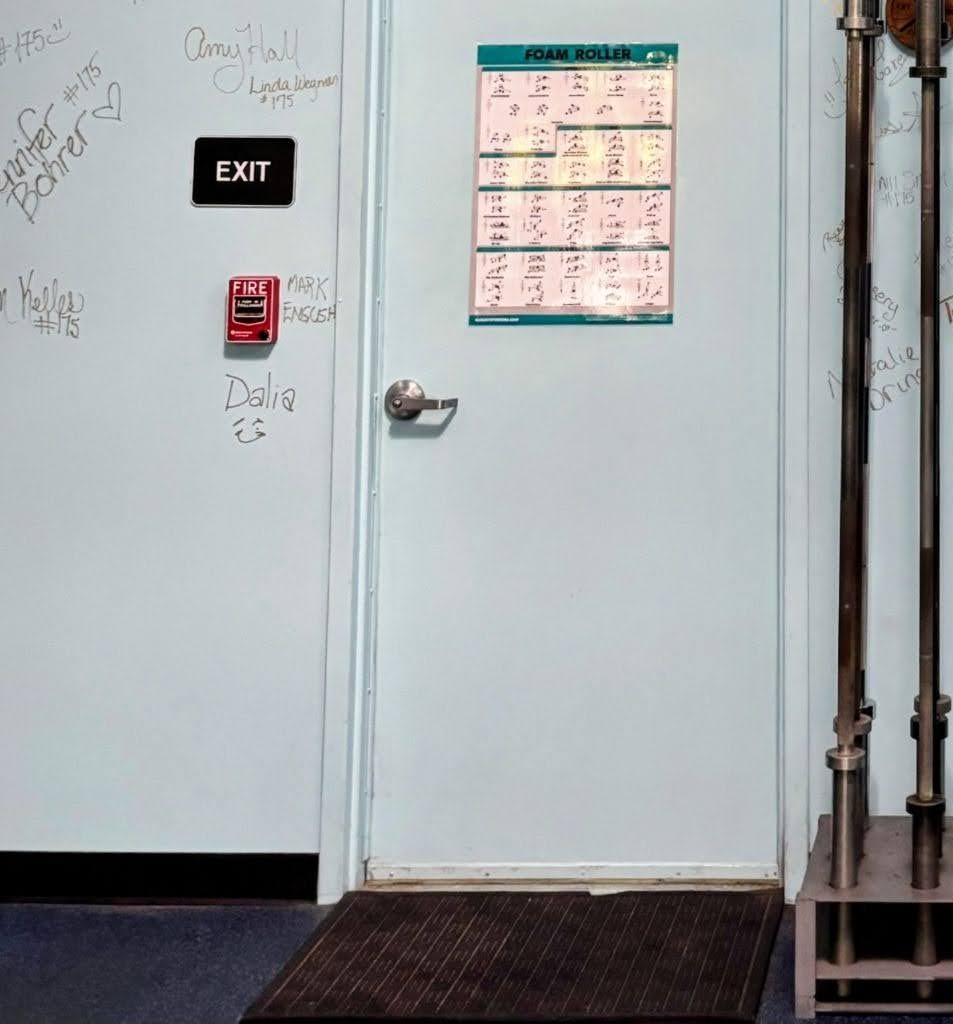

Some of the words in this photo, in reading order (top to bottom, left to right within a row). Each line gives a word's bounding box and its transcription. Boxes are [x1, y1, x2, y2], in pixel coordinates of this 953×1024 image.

[525, 48, 569, 61] FOAM
[575, 48, 631, 60] ROLLER
[0, 103, 57, 192] nnifer
[216, 160, 271, 182] EXIT
[233, 281, 268, 295] FIRE
[288, 274, 329, 301] MARK
[225, 371, 296, 412] Dalia
